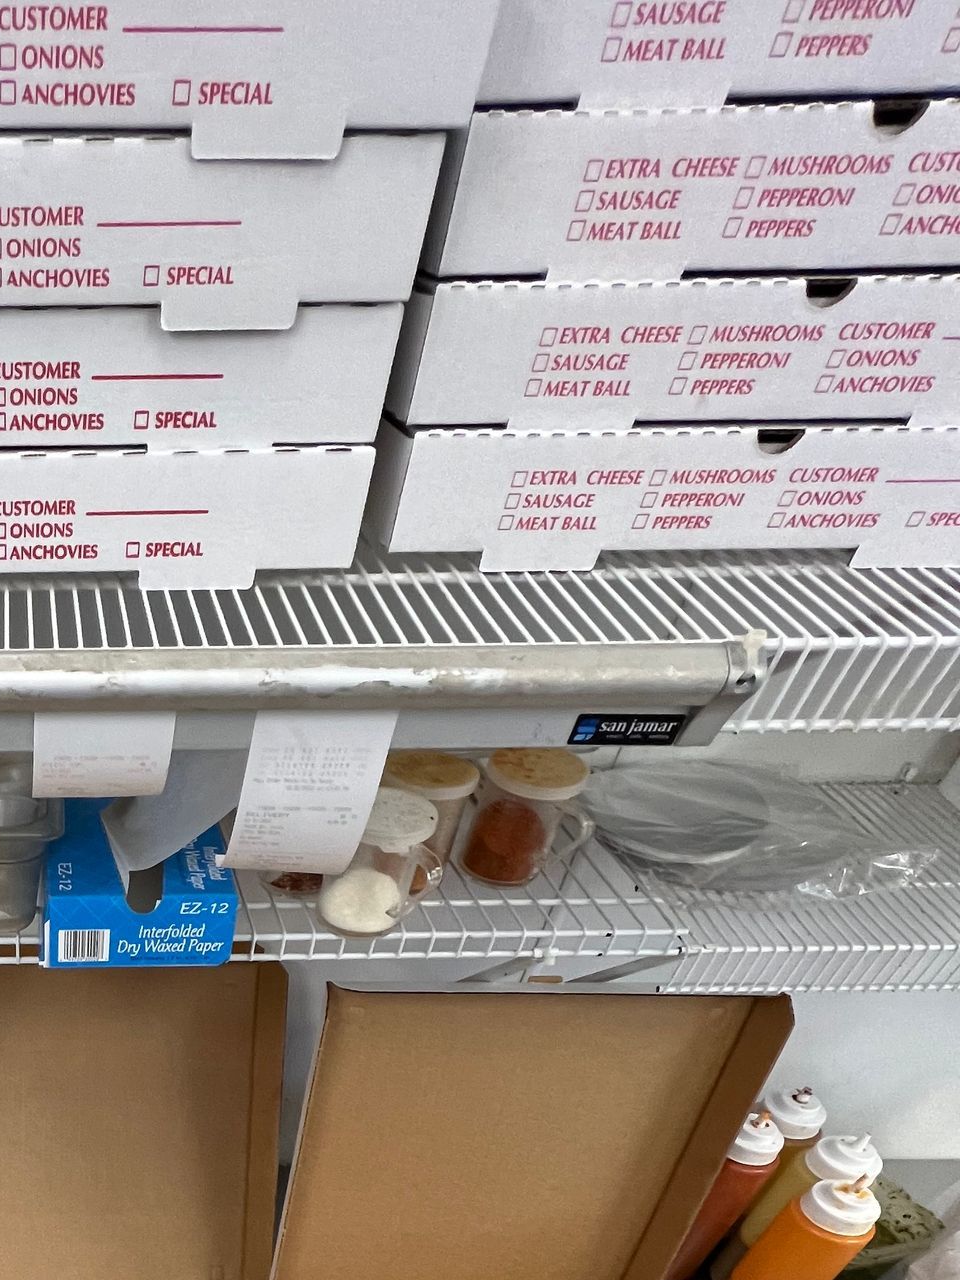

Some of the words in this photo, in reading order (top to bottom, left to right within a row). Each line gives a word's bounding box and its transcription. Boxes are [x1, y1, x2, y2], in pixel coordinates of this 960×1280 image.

[633, 1, 726, 25] SAUSAGE
[809, 0, 914, 20] PEPPERONI
[624, 38, 677, 61] MEAT
[681, 38, 726, 61] BALL
[795, 34, 872, 57] PEPPERS
[21, 46, 105, 69] ONIONS
[21, 82, 135, 107] ANCHOVIES
[198, 81, 273, 106] SPECIAL
[606, 159, 662, 178] EXTRA
[671, 157, 738, 177] CHEESE
[768, 153, 894, 176] MUSHROOMS
[908, 152, 960, 172] CUST
[597, 190, 681, 210] SAUSAGE
[757, 188, 855, 207] PEPPERONI
[587, 222, 637, 241] MEAT
[639, 222, 682, 240] BALL
[746, 219, 816, 238] PEPPERS
[899, 215, 960, 235] ANCH
[6, 238, 81, 259] ONIONS
[7, 268, 111, 288] ANCHOVIES
[166, 266, 234, 287] SPECIAL
[559, 326, 611, 344] EXTRA
[620, 326, 682, 344] CHEESE
[710, 324, 825, 342] MUSHROOMS
[838, 321, 936, 341] CUSTOMER
[552, 354, 630, 371] SAUSAGE
[701, 352, 791, 369] PEPPERONI
[847, 350, 919, 365] ONIONS
[544, 381, 589, 397] MEAT
[592, 380, 630, 397] BALL
[690, 379, 754, 396] PEPPERS
[836, 375, 935, 394] ANCHOVIES
[10, 388, 78, 405] ONIONS
[8, 412, 105, 432] ANCHOVIES
[155, 410, 218, 429] SPECIAL
[530, 469, 577, 484] EXTRA
[587, 470, 644, 485] CHEESE
[670, 469, 777, 484] MUSHROOMS
[789, 467, 879, 483] CUSTOMER
[523, 494, 594, 507] SAUSAGE
[663, 492, 744, 507] PEPPERONI
[796, 490, 865, 505] ONIONS
[515, 515, 559, 531] MEAT
[561, 516, 597, 531] BALL
[652, 514, 712, 529] PEPPERS
[782, 512, 880, 528] ANCHOVIES
[10, 523, 73, 538] ONIONS
[10, 543, 99, 560] ANCHOVIES
[145, 541, 203, 559] SPECIAL
[599, 721, 627, 732] san
[626, 719, 677, 736] jamar
[58, 862, 72, 891] EZ-12
[180, 902, 229, 915] EZ-12
[139, 923, 206, 942] Interfolded
[117, 939, 141, 957] Dry
[144, 939, 186, 953] Waxed
[188, 938, 224, 956] Paper
